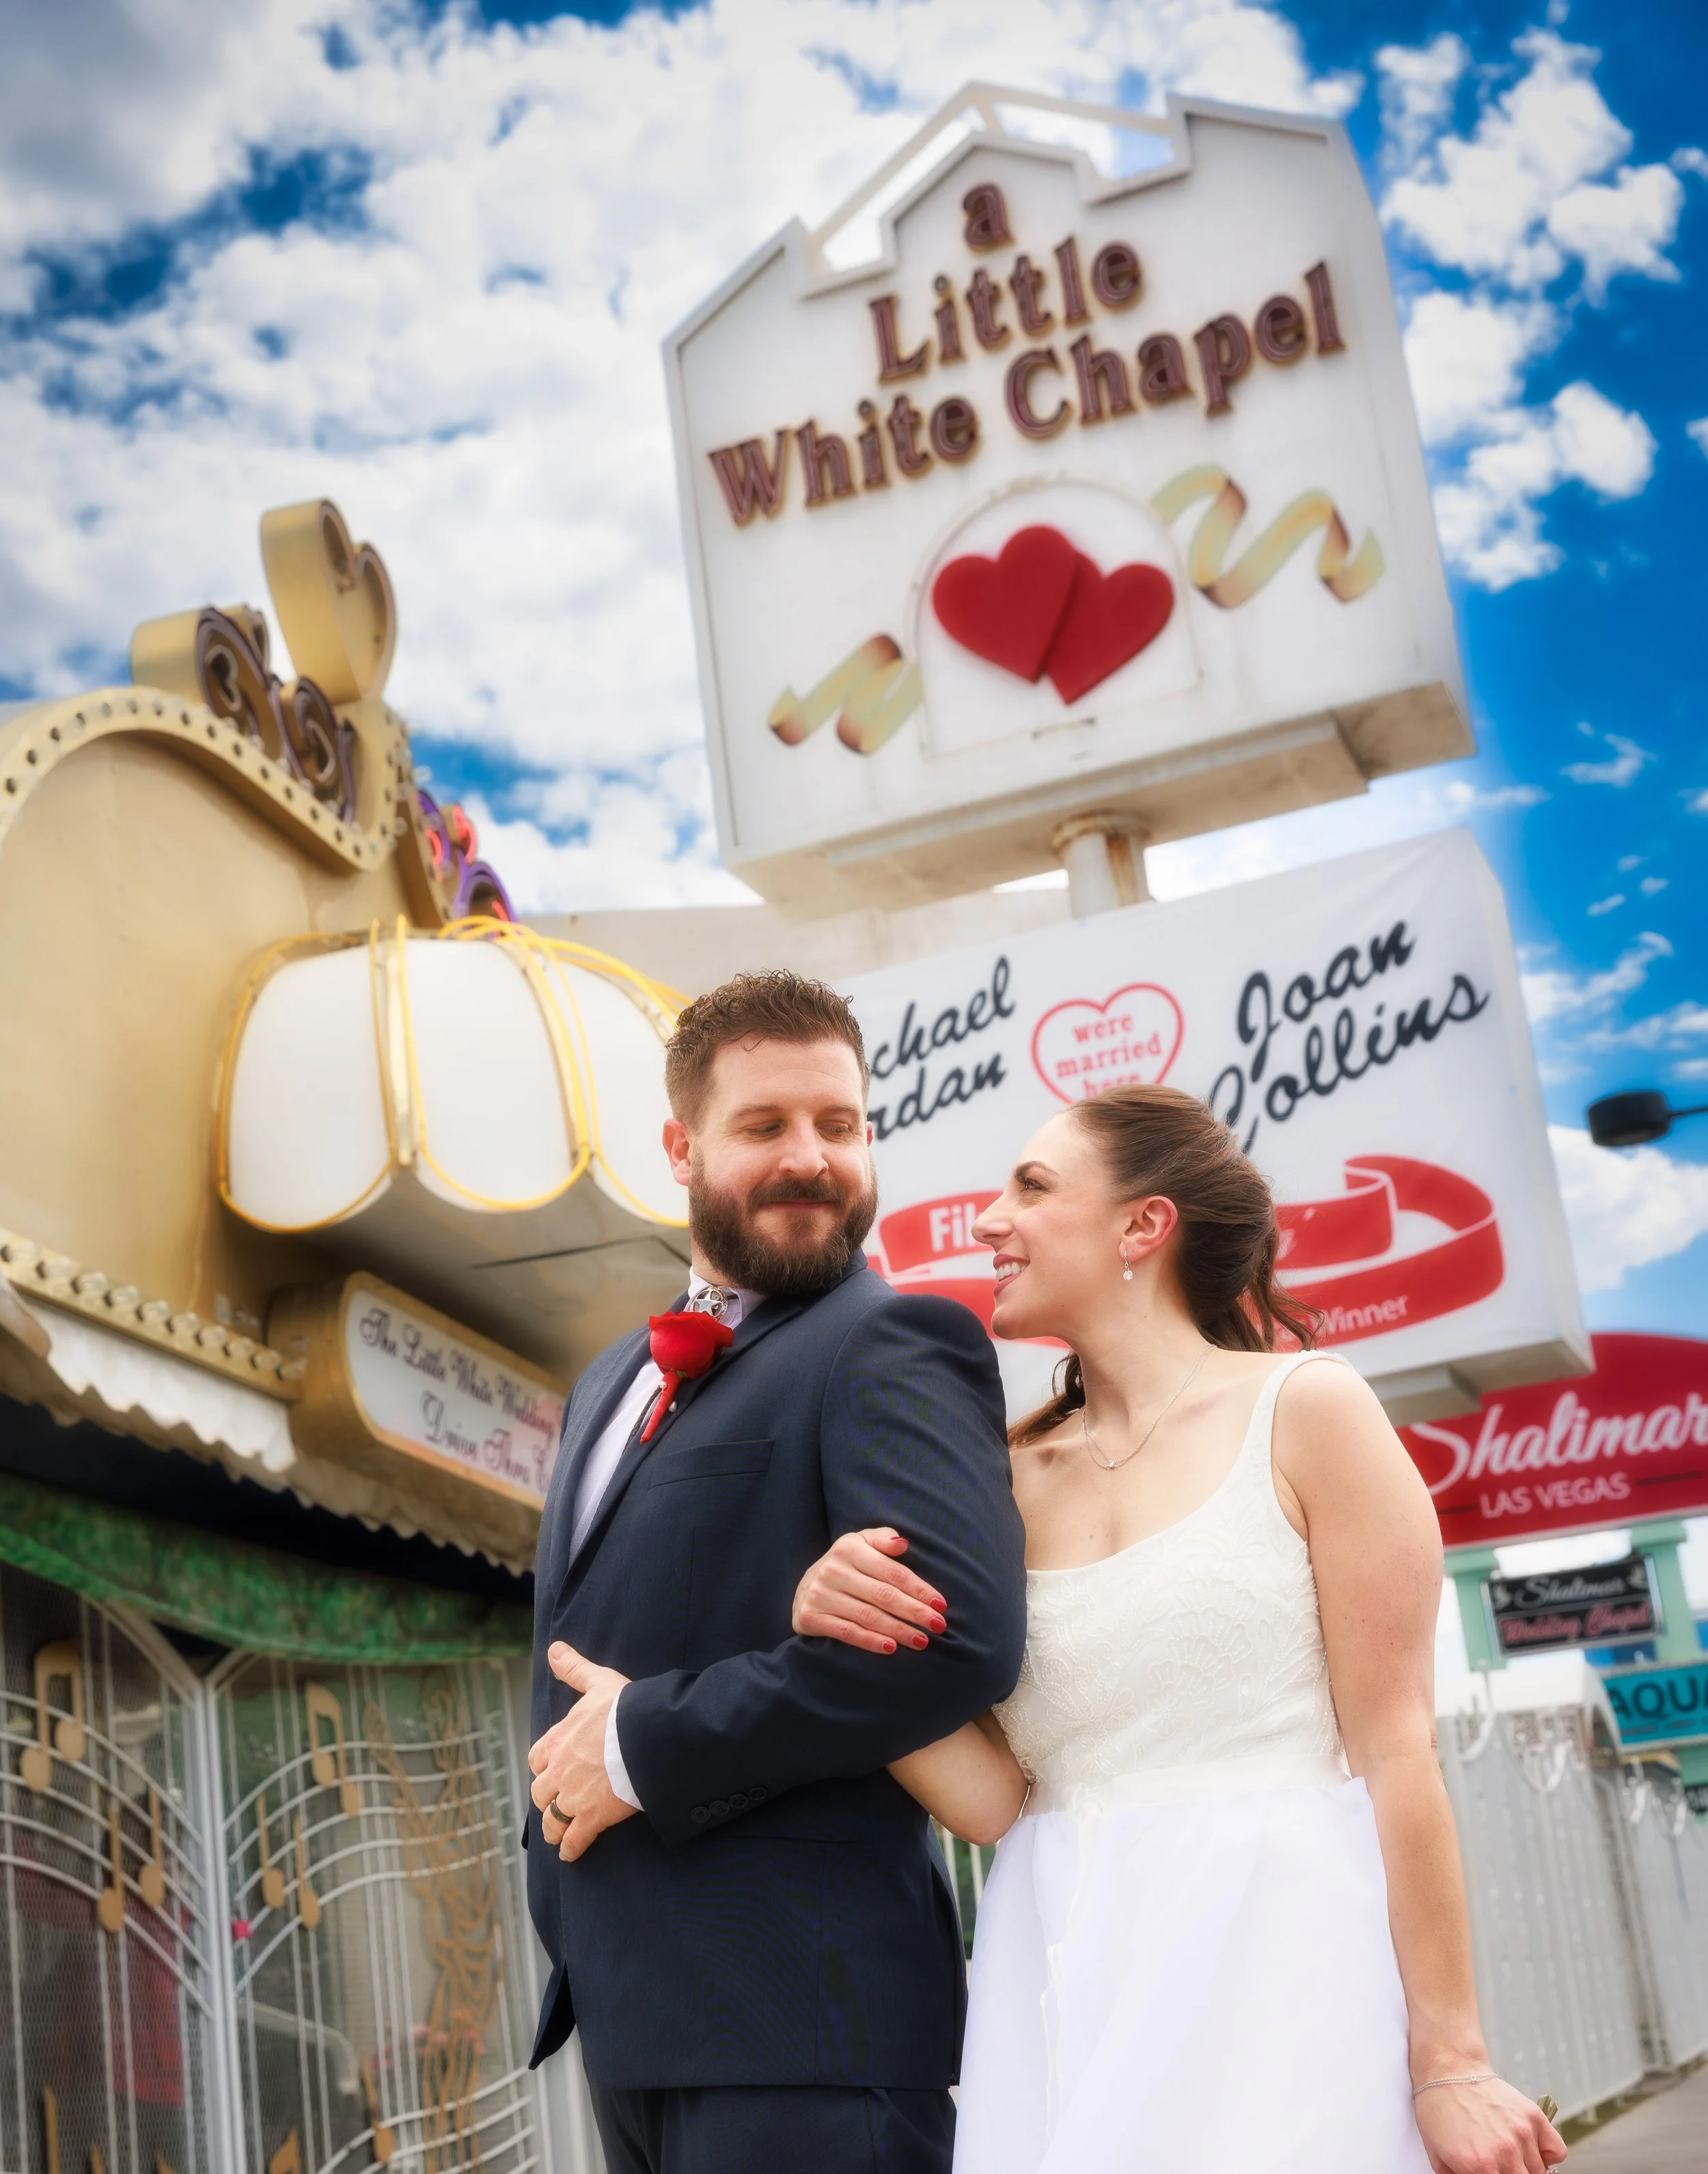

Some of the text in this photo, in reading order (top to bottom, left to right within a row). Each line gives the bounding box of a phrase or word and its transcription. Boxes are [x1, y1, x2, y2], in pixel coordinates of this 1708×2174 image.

[963, 182, 1015, 251] a
[869, 236, 1144, 385] Little
[709, 260, 1346, 527] White Chapel
[871, 954, 1016, 1079] chael
[1073, 1013, 1133, 1044] were
[1237, 920, 1415, 1083] Joan
[1056, 1034, 1162, 1078] married
[359, 1307, 398, 1358] The
[1309, 1295, 1408, 1336] Winner
[1409, 1391, 1708, 1496] Shalimar
[1480, 1472, 1631, 1519] LAS VEGAS
[1607, 1677, 1708, 1720] AQU
